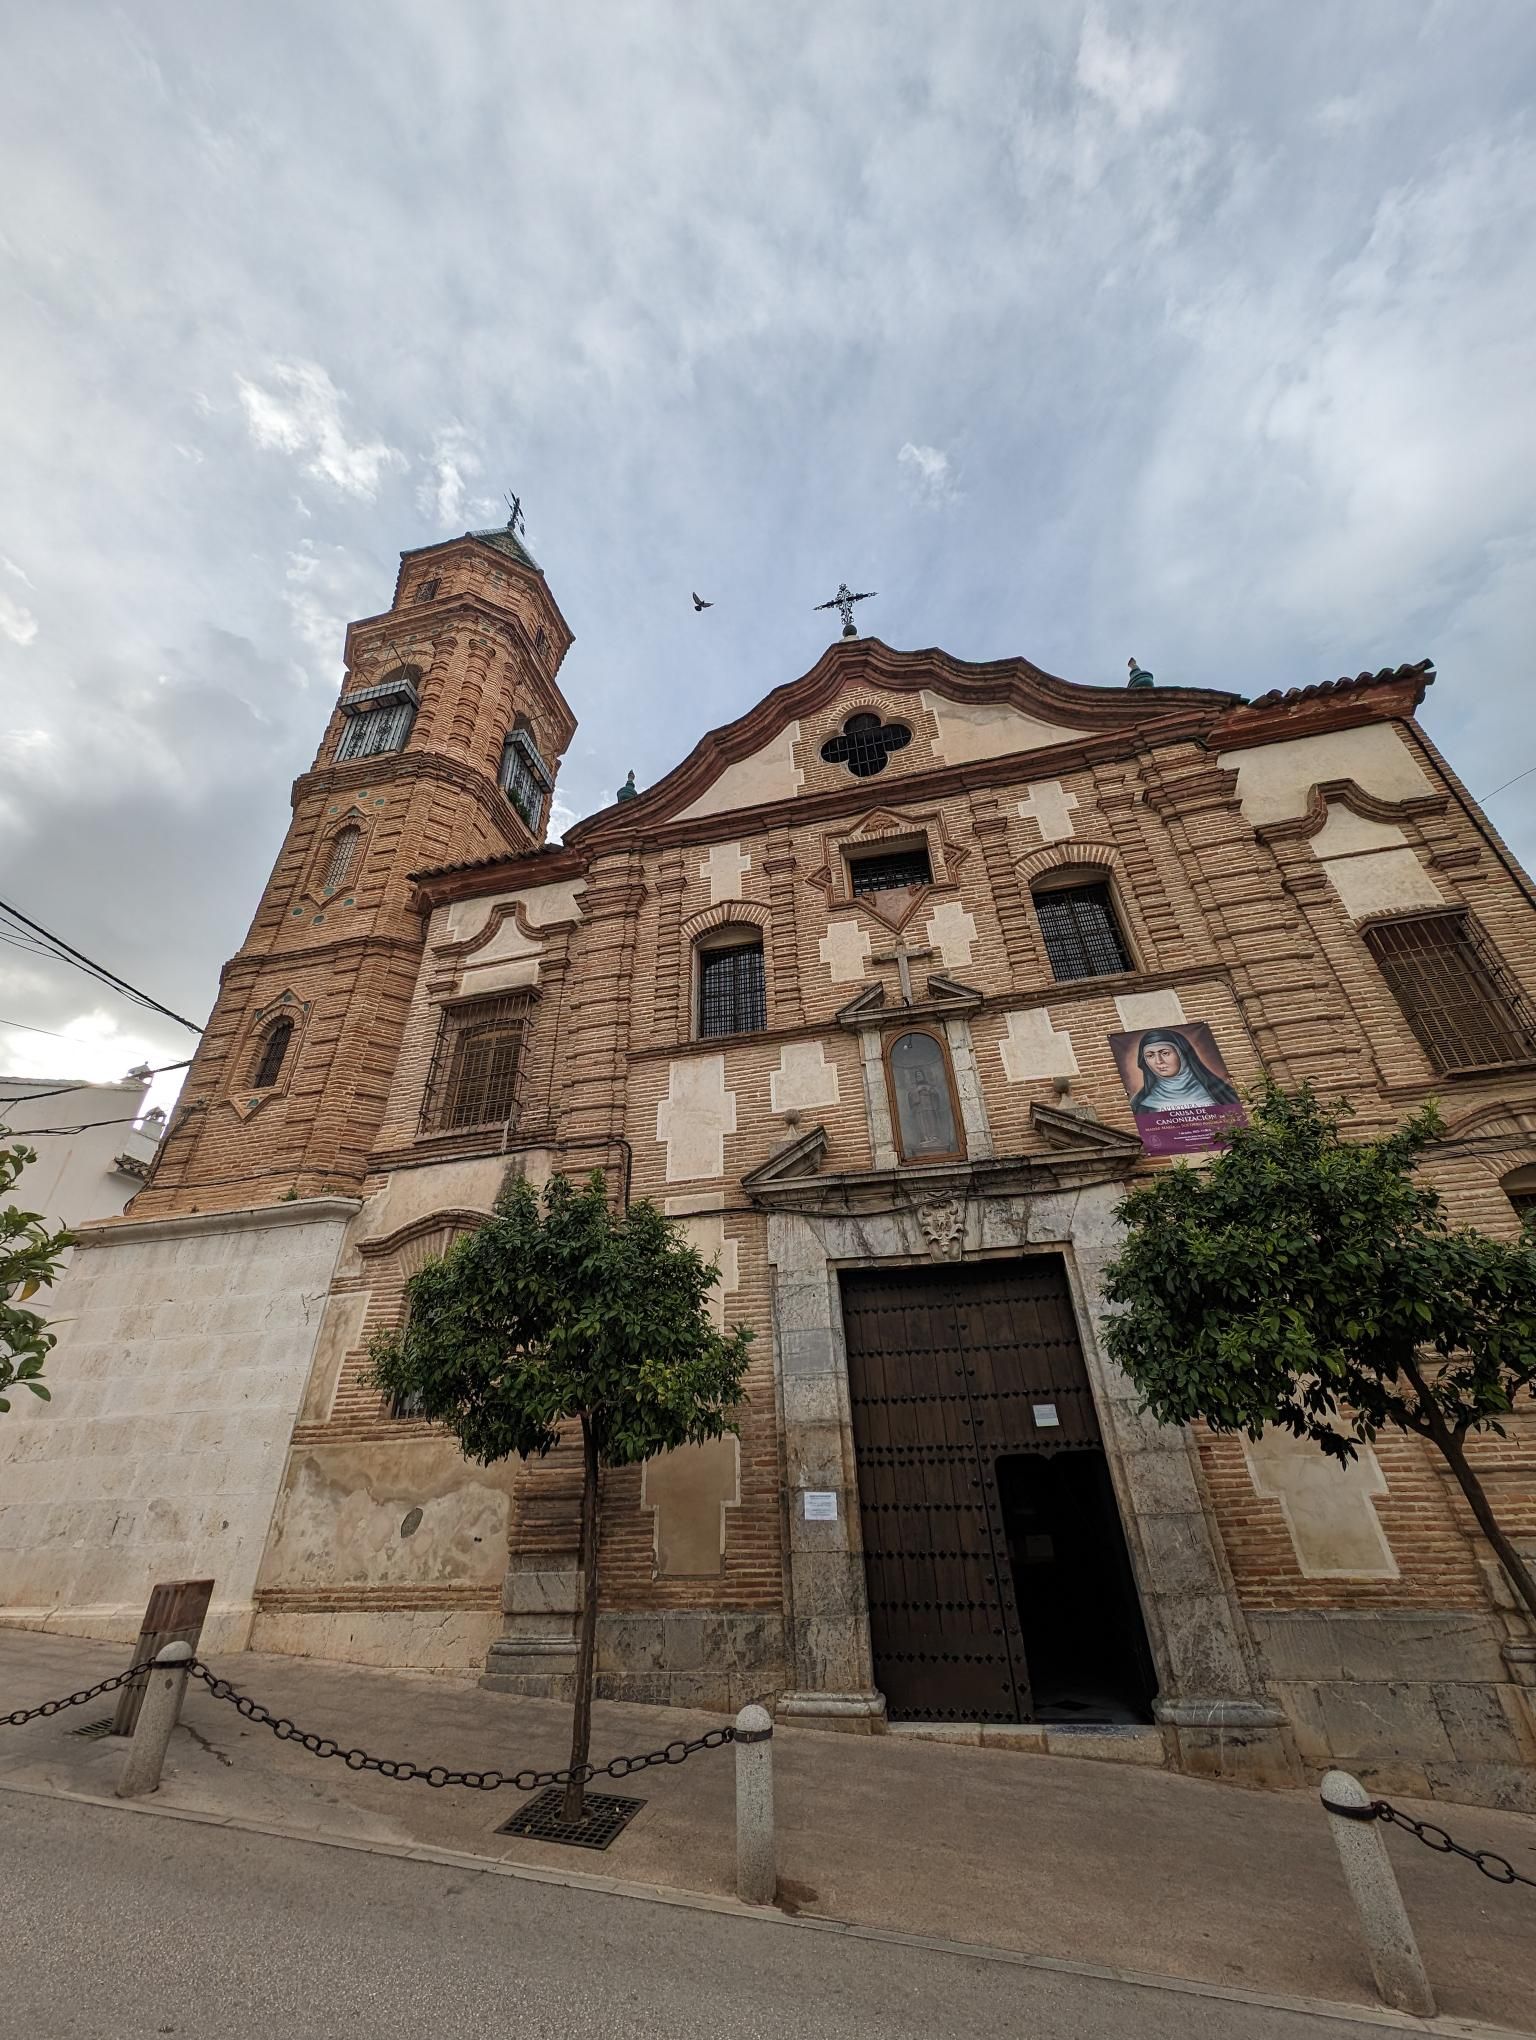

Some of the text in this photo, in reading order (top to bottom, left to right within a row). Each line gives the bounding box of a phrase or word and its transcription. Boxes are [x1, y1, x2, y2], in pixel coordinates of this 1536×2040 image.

[1169, 1107, 1207, 1117] CAUSA DE
[1156, 1113, 1217, 1126] CANONIZACIÓN
